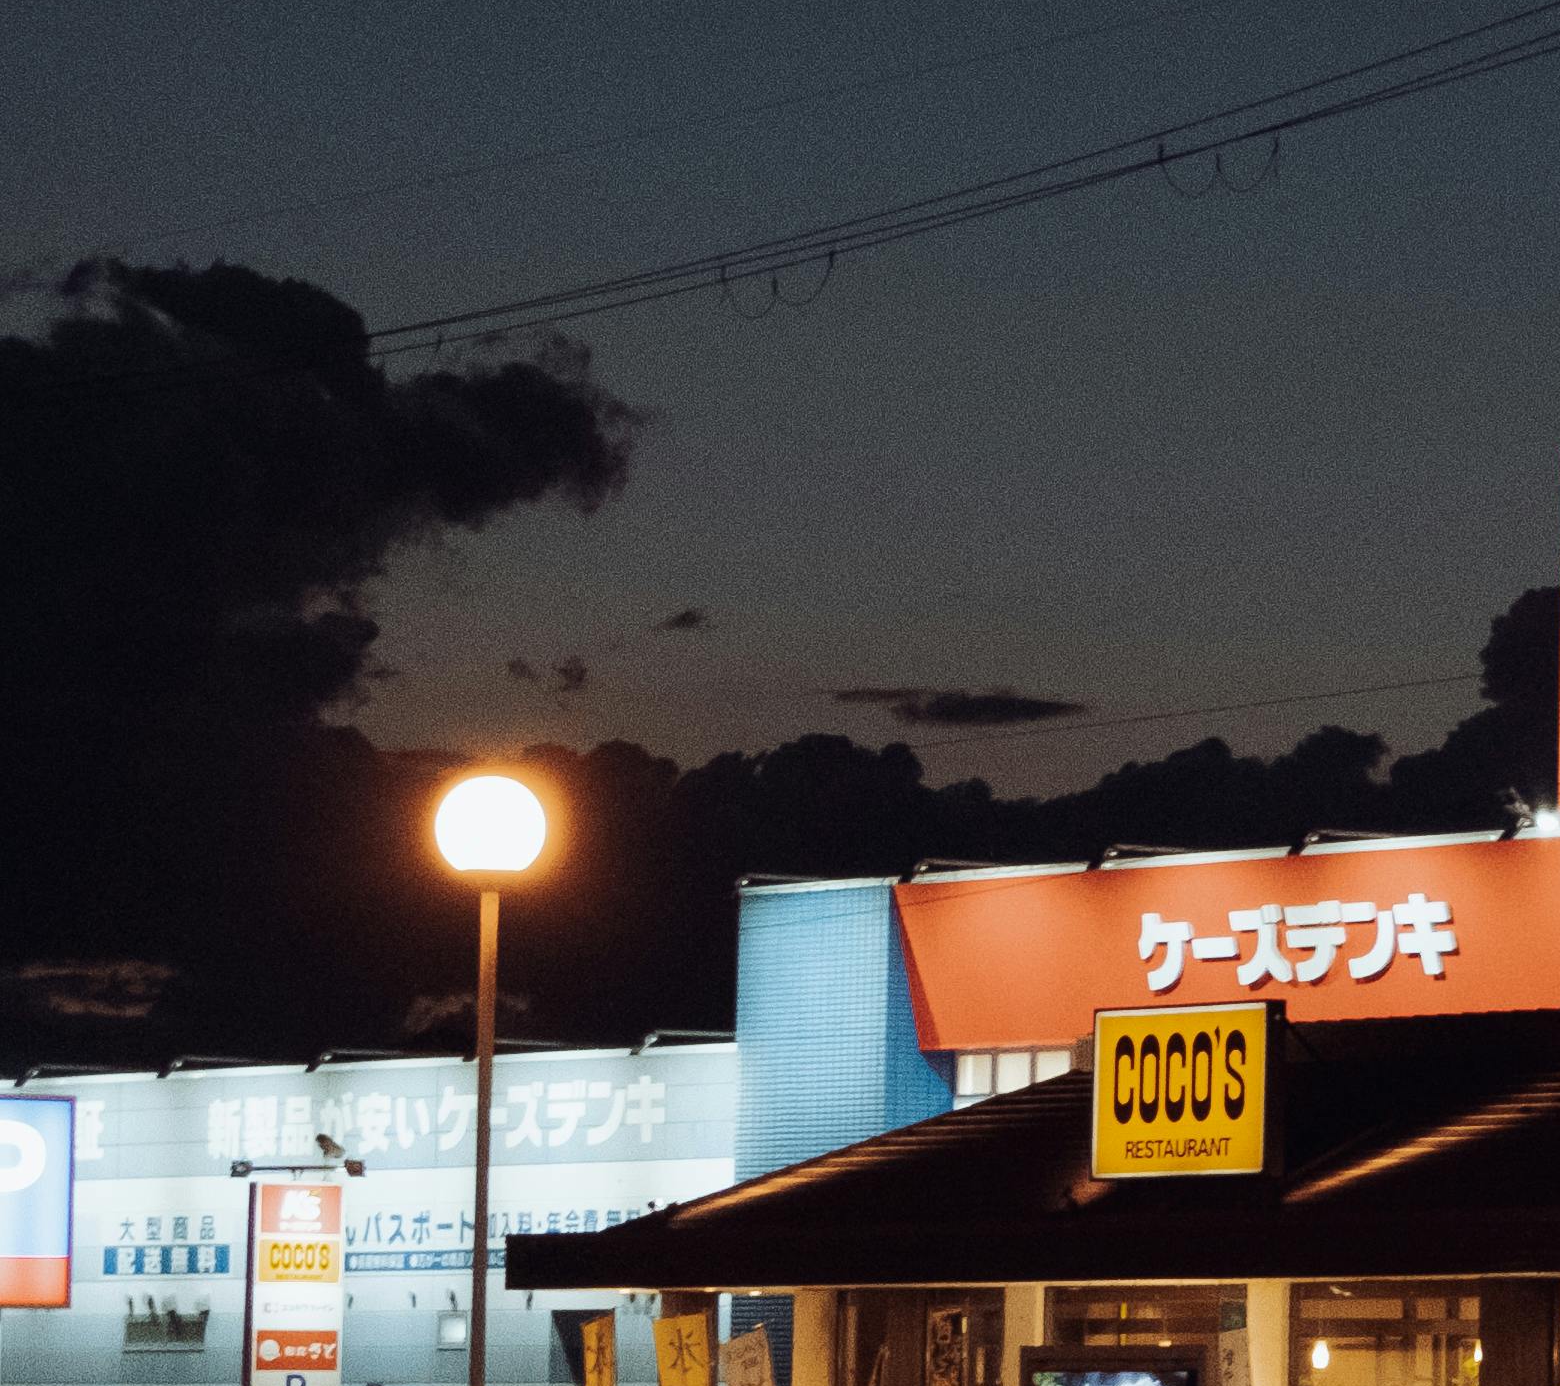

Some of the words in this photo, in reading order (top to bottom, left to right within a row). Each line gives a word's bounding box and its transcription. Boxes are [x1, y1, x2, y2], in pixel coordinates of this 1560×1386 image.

[1137, 893, 1458, 993] ケーズデンキ
[1114, 1026, 1246, 1125] COCO'S
[1124, 1136, 1232, 1161] RESTAURANT
